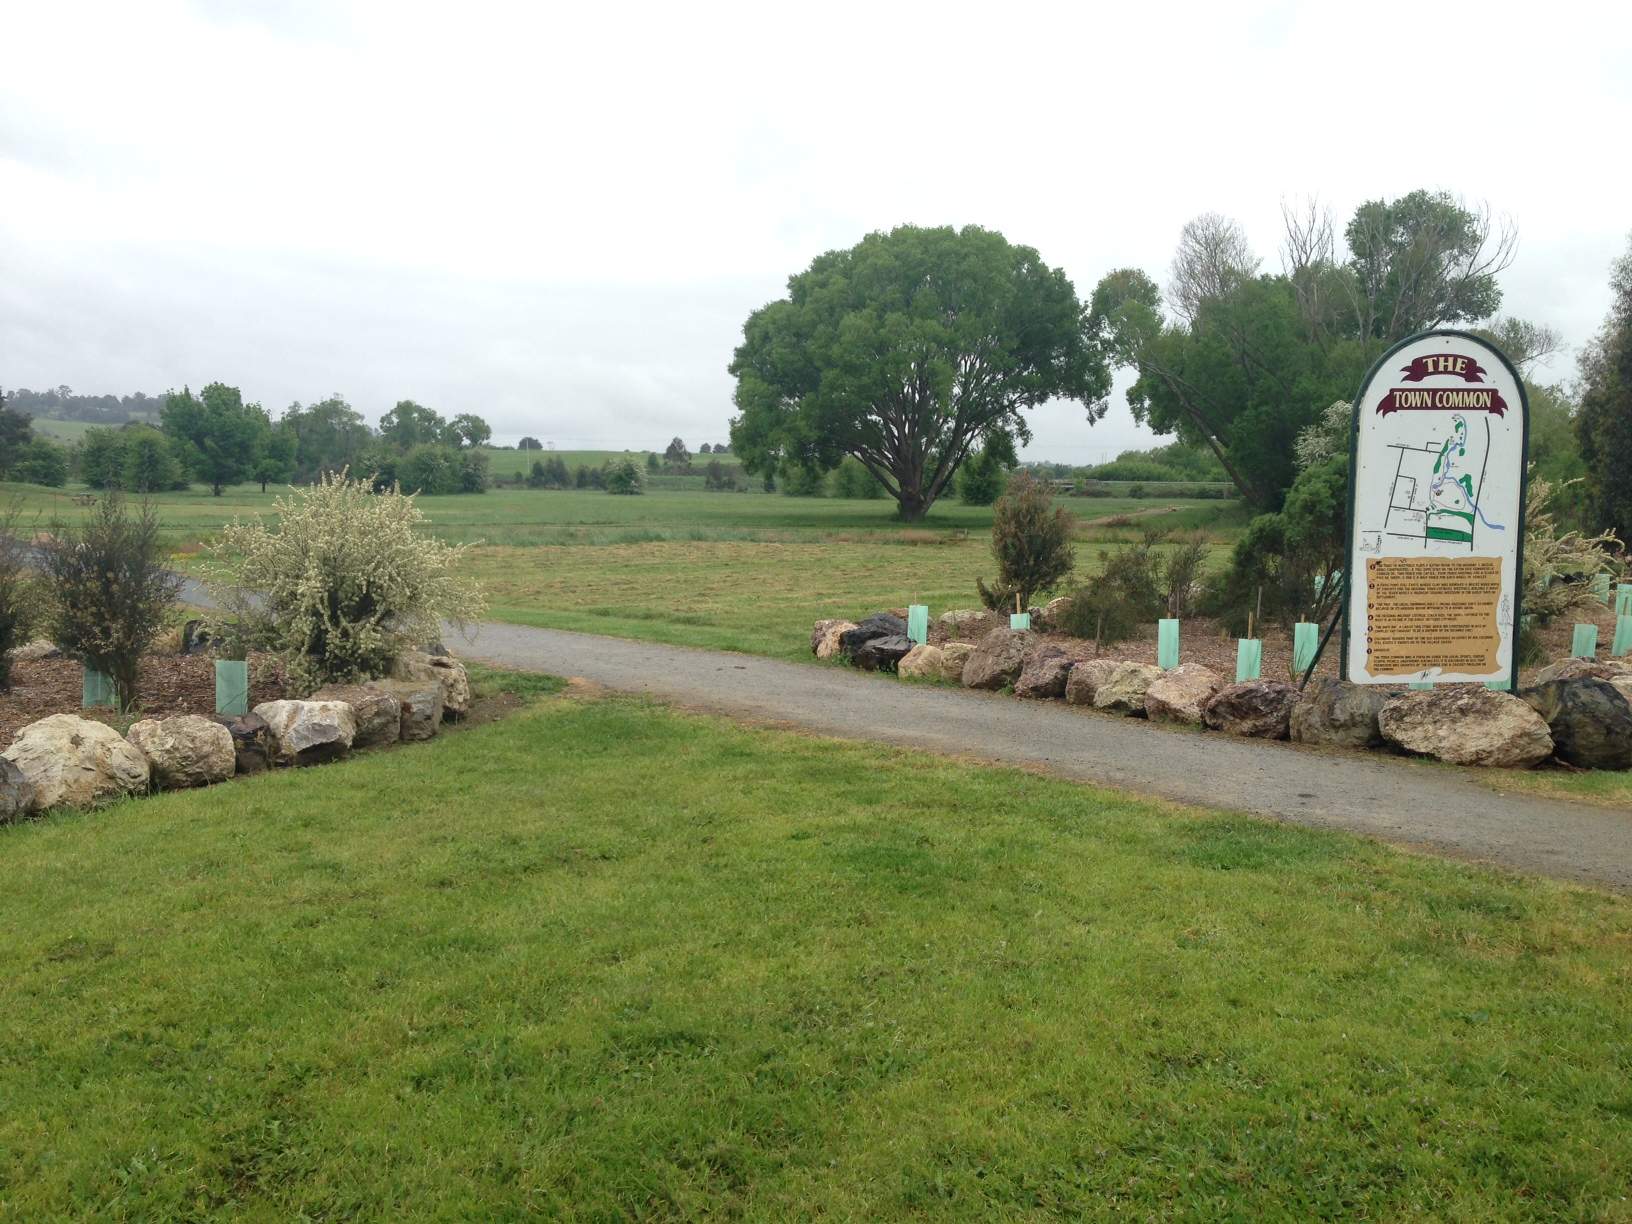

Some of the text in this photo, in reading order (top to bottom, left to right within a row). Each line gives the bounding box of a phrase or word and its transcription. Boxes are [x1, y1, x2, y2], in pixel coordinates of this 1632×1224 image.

[1423, 356, 1468, 373] THE
[1393, 391, 1492, 408] TOWN COMMON
